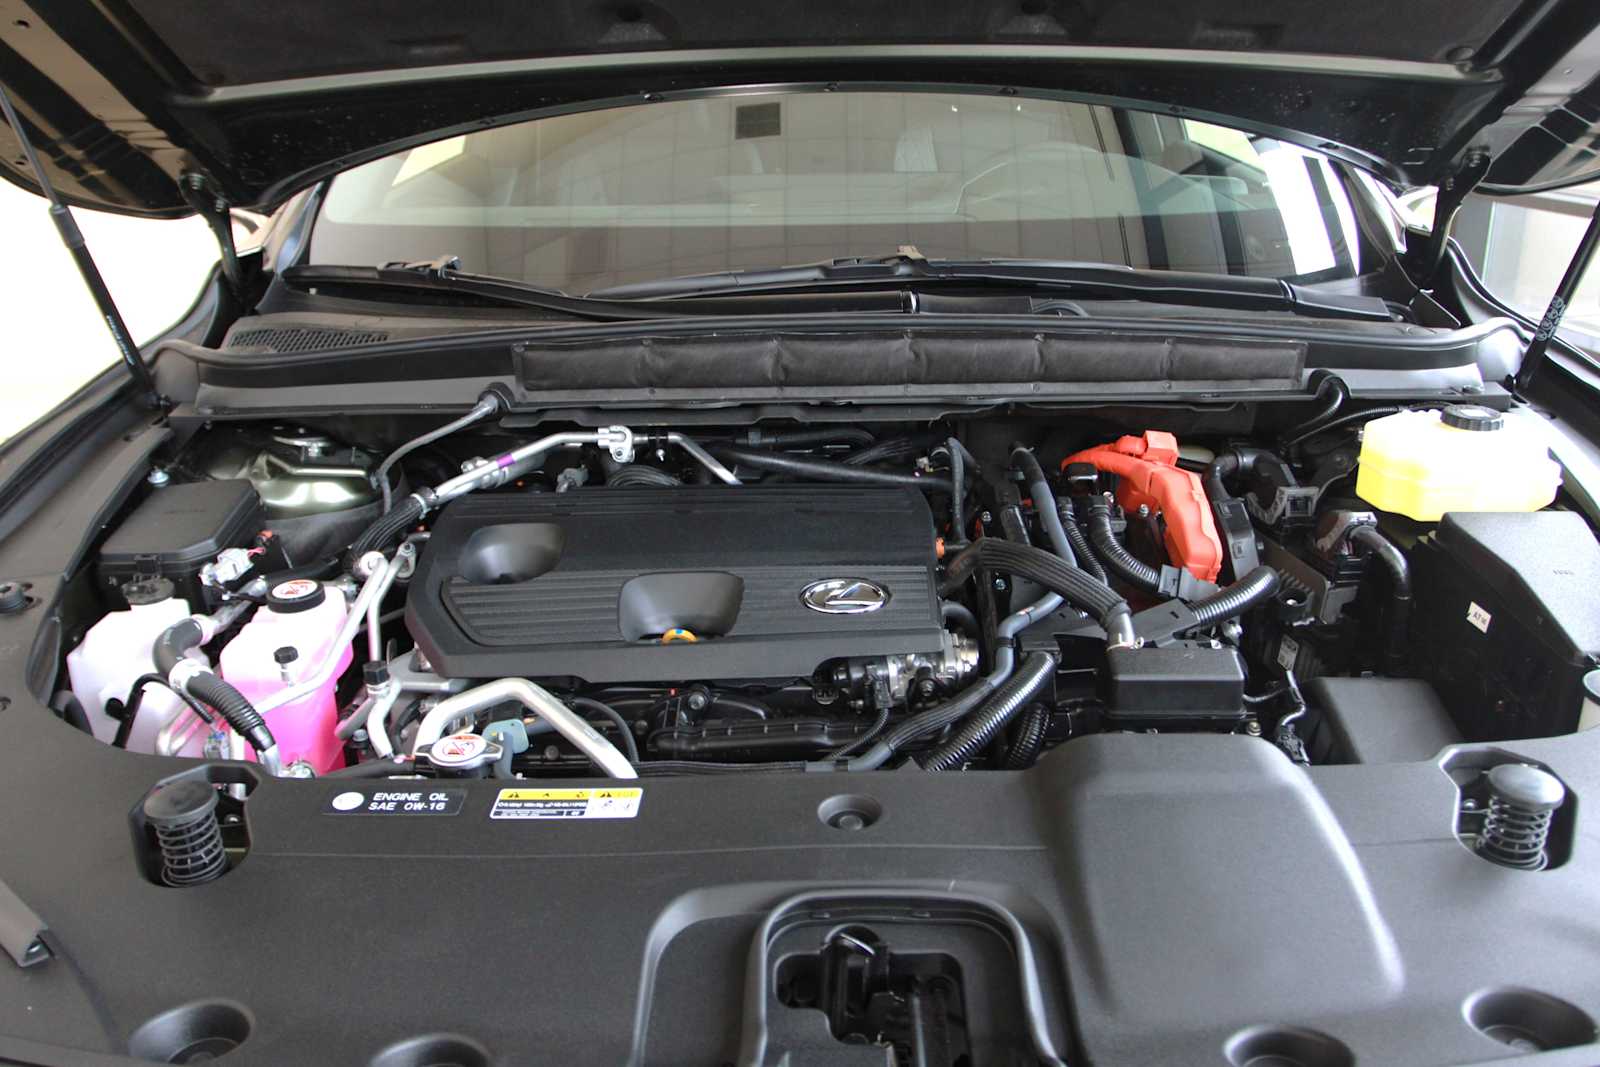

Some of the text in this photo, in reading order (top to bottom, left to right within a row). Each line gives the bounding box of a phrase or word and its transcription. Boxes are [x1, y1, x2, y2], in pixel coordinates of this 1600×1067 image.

[372, 792, 449, 801] ENGINE OIL
[368, 801, 446, 811] SAE 0W-16
